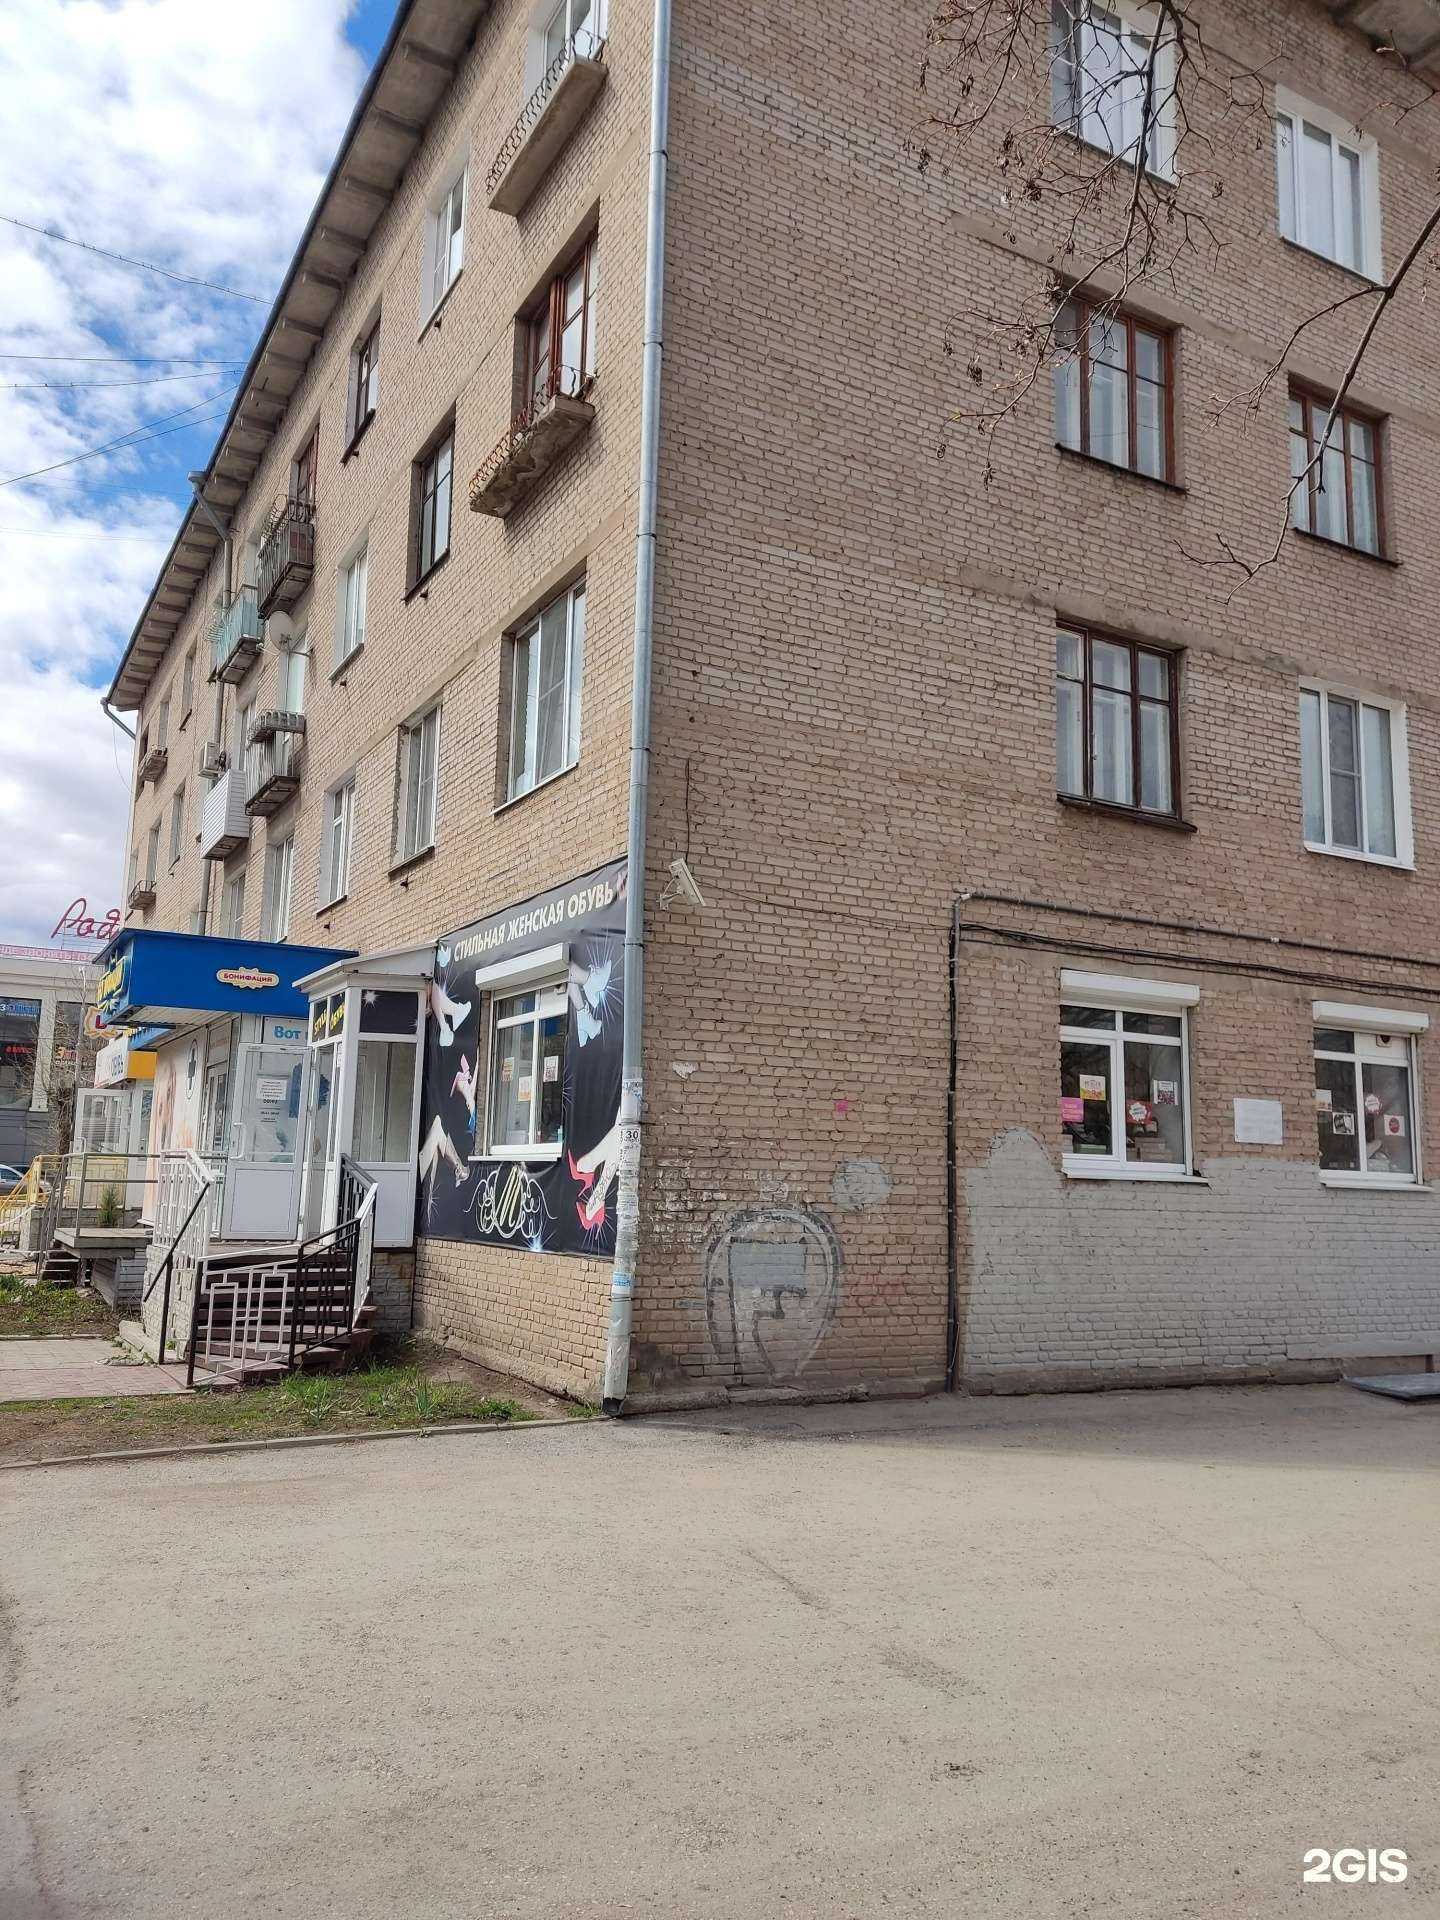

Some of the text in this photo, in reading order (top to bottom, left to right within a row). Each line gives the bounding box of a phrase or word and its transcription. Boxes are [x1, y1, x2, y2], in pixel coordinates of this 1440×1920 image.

[453, 924, 506, 962] СТИЛЬНАЯ
[507, 900, 565, 942] ЖЕНСКАЯ
[567, 881, 613, 919] ОБУВЬ
[274, 1025, 301, 1040] Вот
